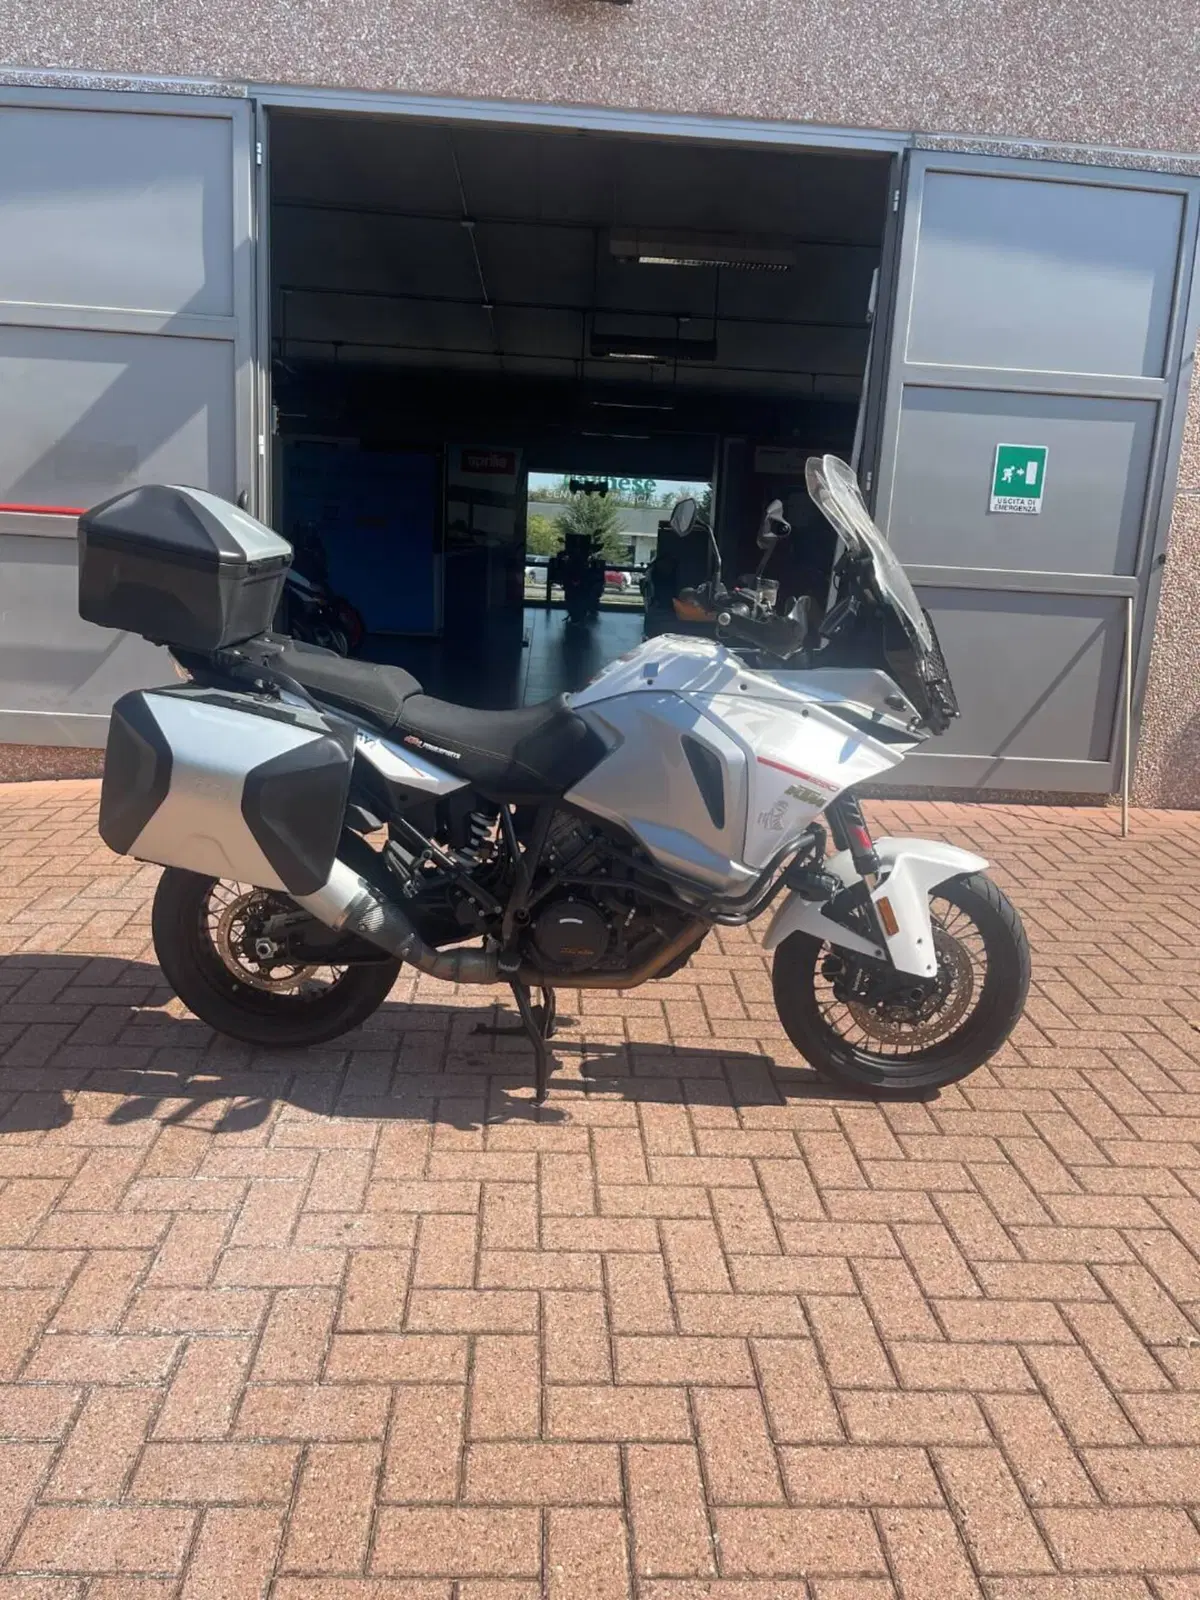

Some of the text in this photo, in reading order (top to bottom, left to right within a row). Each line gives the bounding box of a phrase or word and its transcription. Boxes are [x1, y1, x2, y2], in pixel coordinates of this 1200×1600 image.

[467, 453, 507, 469] aprilia
[994, 503, 1037, 512] EMERGENZA
[784, 783, 828, 808] KTM
